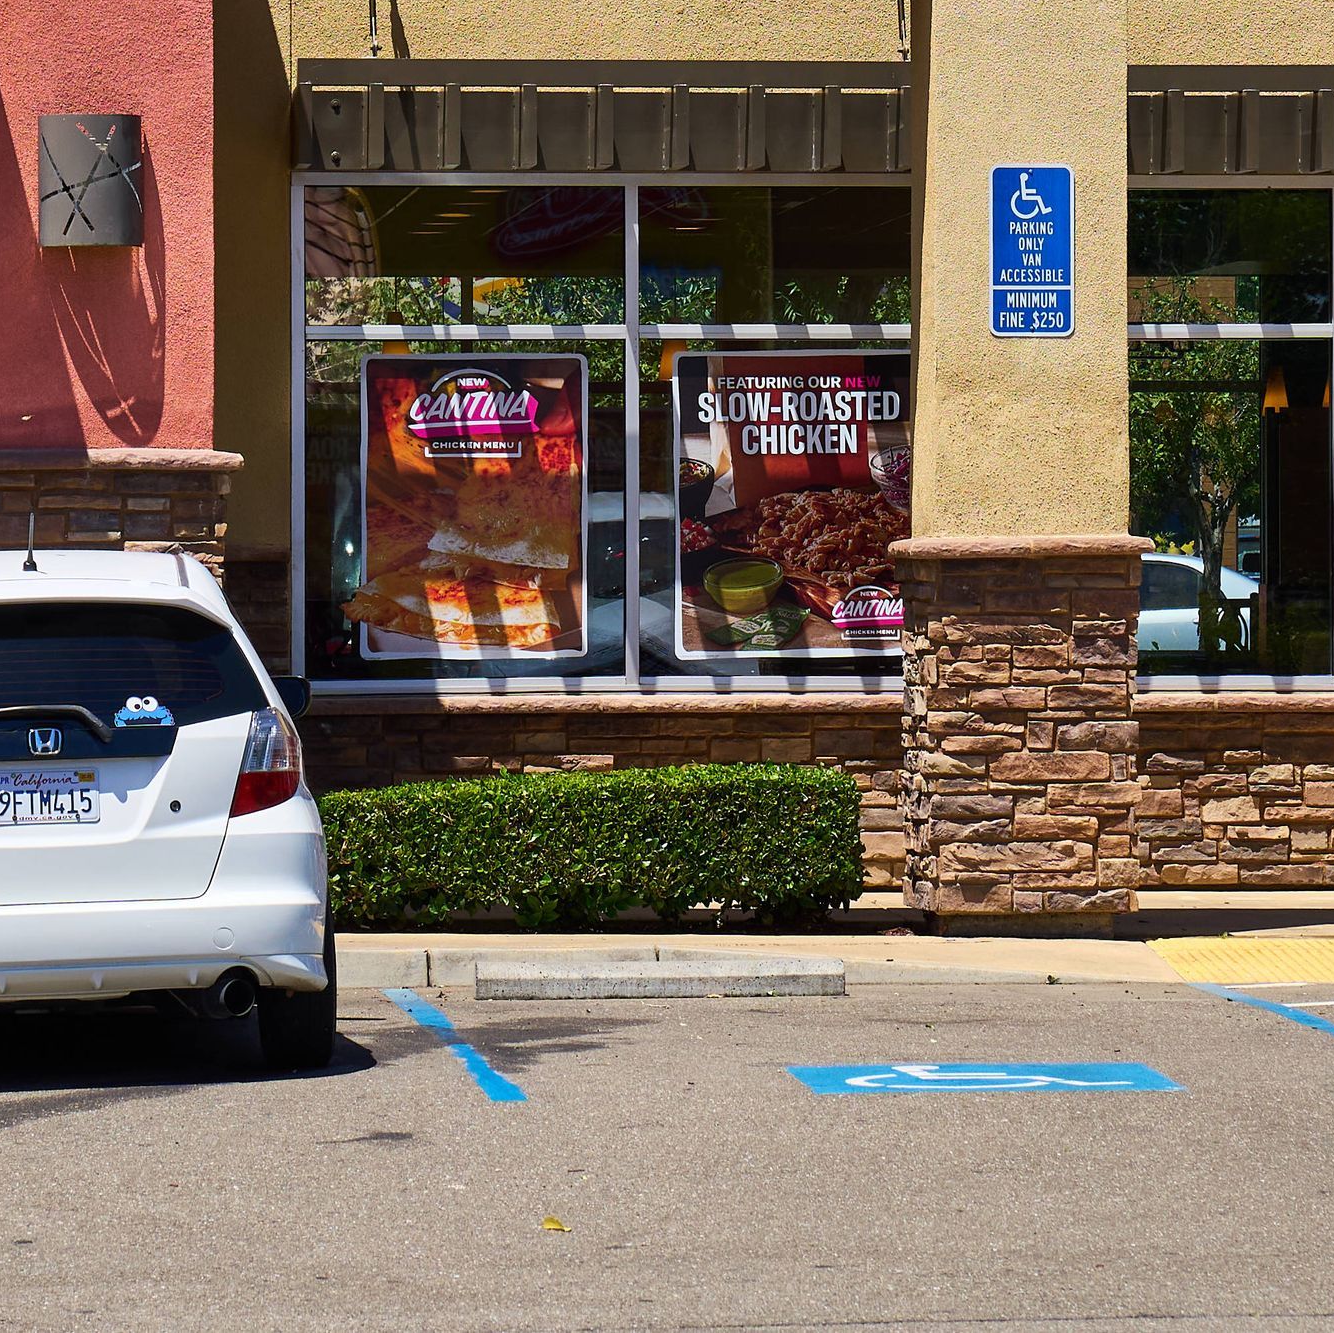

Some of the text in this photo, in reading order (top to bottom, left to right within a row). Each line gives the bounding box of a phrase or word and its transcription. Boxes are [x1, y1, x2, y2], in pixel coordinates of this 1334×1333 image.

[1009, 221, 1054, 235] PARKING
[1018, 237, 1044, 250] ONLY
[1022, 253, 1042, 266] VAN
[1000, 269, 1064, 282] ACCESSIBLE
[1007, 292, 1057, 308] MINIMUM
[999, 310, 1064, 329] FINE $250
[457, 378, 487, 386] NEW
[718, 376, 881, 389] FEATURING OUR NEW
[409, 389, 530, 421] CANTINA
[698, 391, 901, 423] SLOW-ROASTED
[432, 441, 514, 449] CHICKEN MENU
[742, 424, 858, 455] CHICKEN
[831, 598, 904, 619] CANTINA
[13, 773, 79, 789] California
[0, 788, 92, 816] 9FTM415
